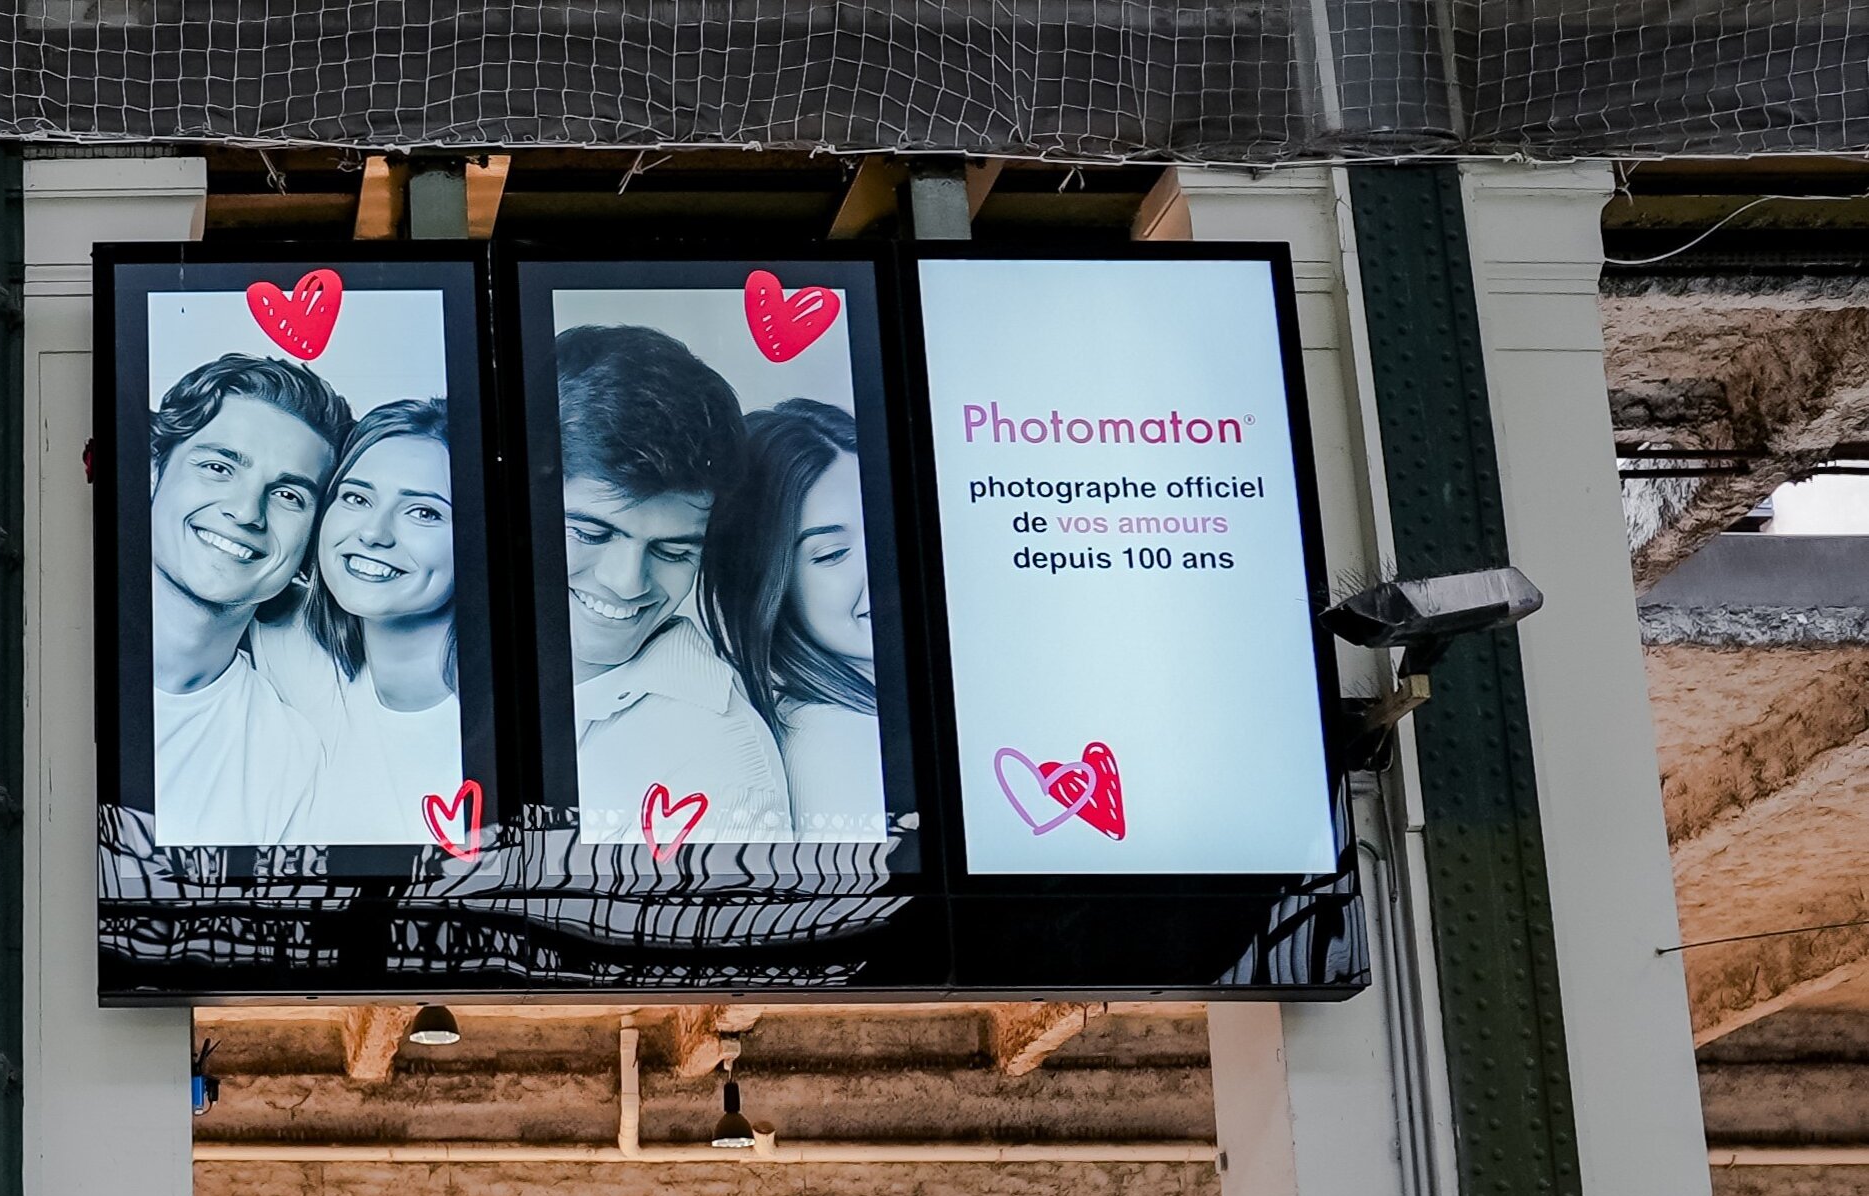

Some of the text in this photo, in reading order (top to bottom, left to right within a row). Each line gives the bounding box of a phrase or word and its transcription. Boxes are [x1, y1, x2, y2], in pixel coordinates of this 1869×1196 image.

[969, 476, 1265, 504] photographe officiel
[1012, 511, 1229, 534] de vos amours
[1013, 547, 1235, 574] depuis 100 ans
